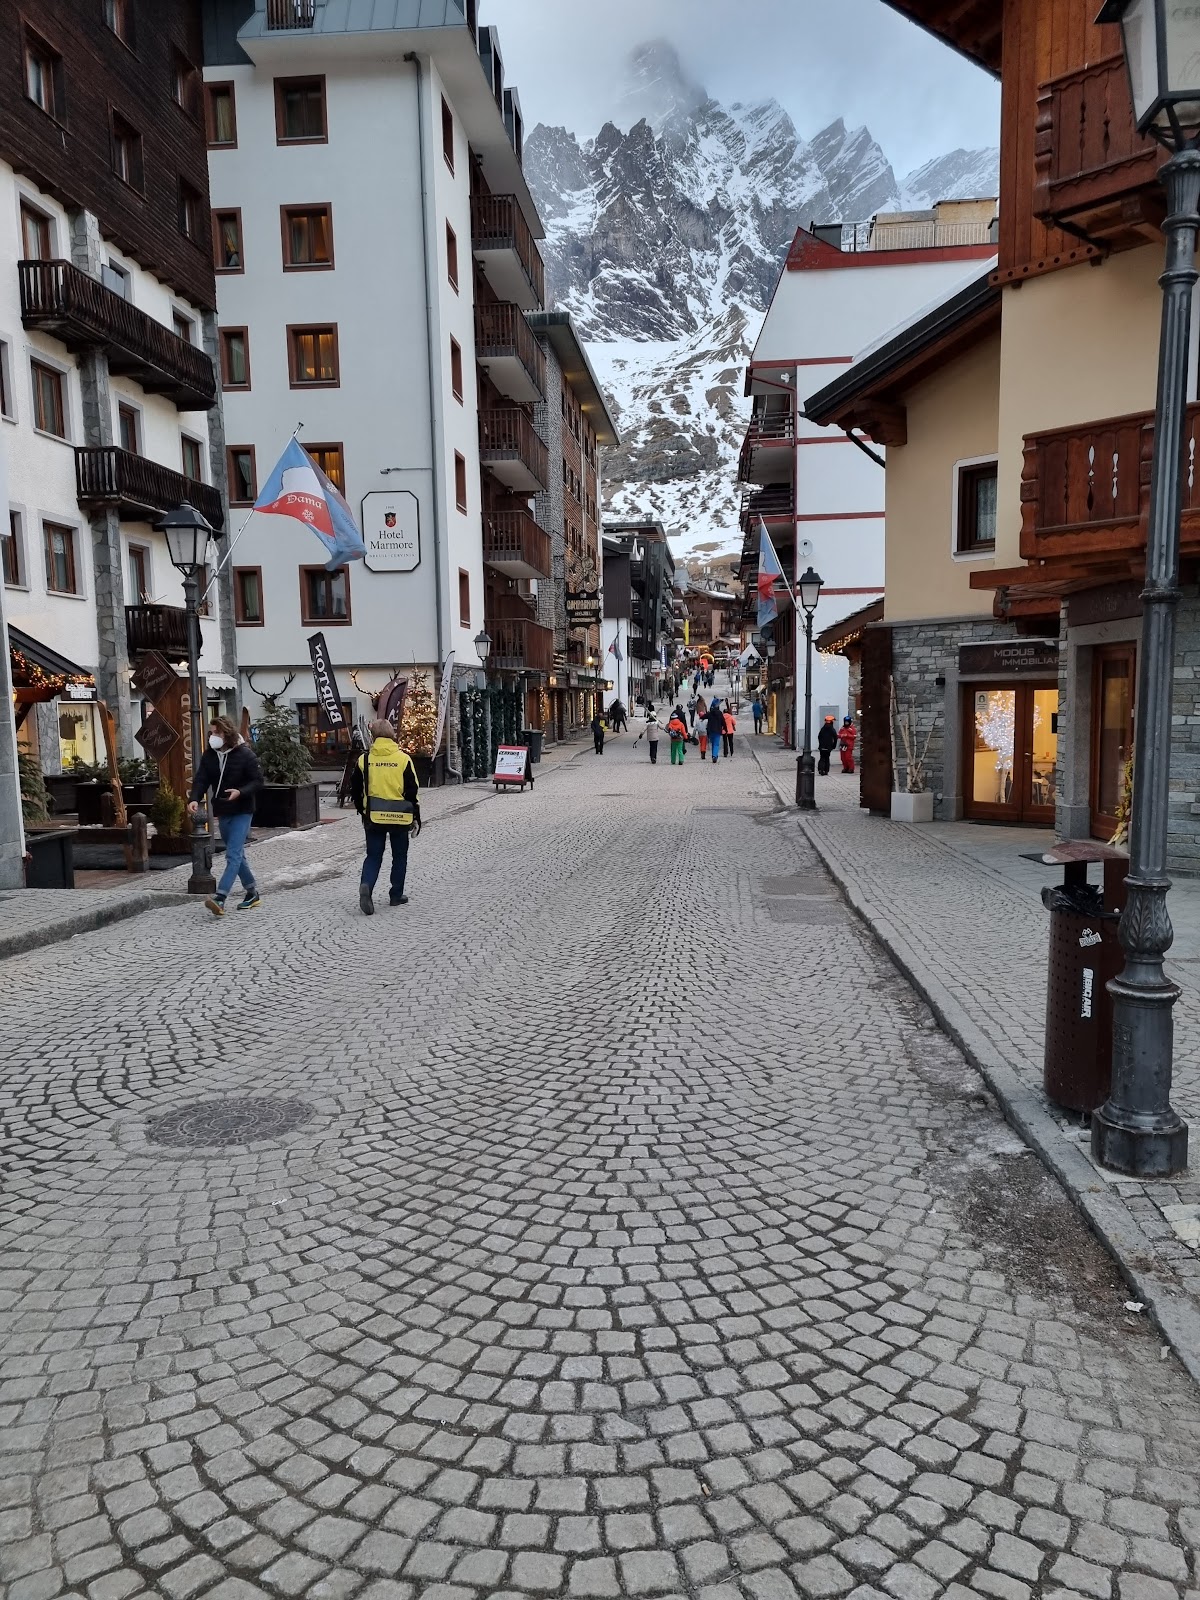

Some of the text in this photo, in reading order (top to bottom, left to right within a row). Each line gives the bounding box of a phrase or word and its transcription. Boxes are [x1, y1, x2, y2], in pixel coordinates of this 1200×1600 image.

[286, 494, 322, 509] Dama
[379, 530, 404, 540] Hotel
[370, 541, 413, 550] Marmore
[993, 648, 1035, 658] MODUS
